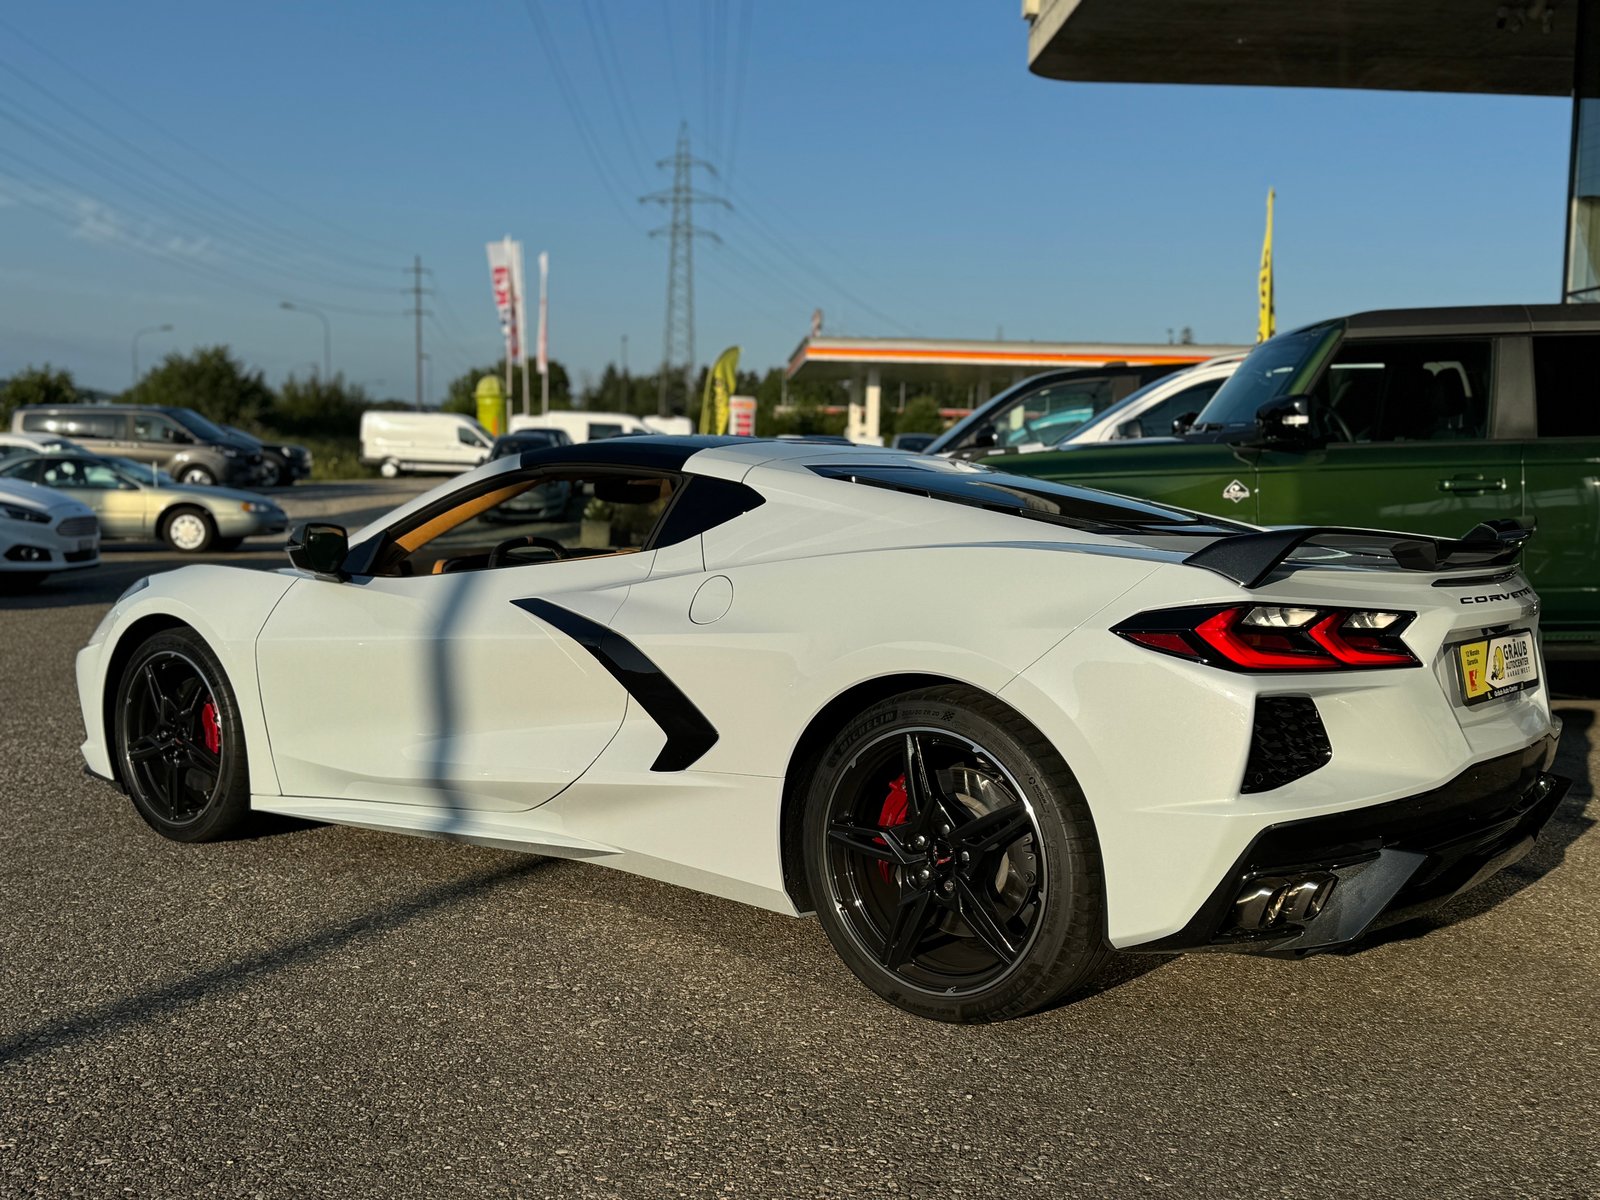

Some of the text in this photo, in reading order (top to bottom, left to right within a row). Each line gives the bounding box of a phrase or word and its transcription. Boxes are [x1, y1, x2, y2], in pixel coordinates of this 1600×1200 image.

[1460, 586, 1531, 604] CORVETTE
[1503, 638, 1528, 660] GRÄUB
[1506, 657, 1529, 670] AUTOCENTER
[1521, 666, 1531, 674] WEST
[840, 711, 895, 754] MICHELIN
